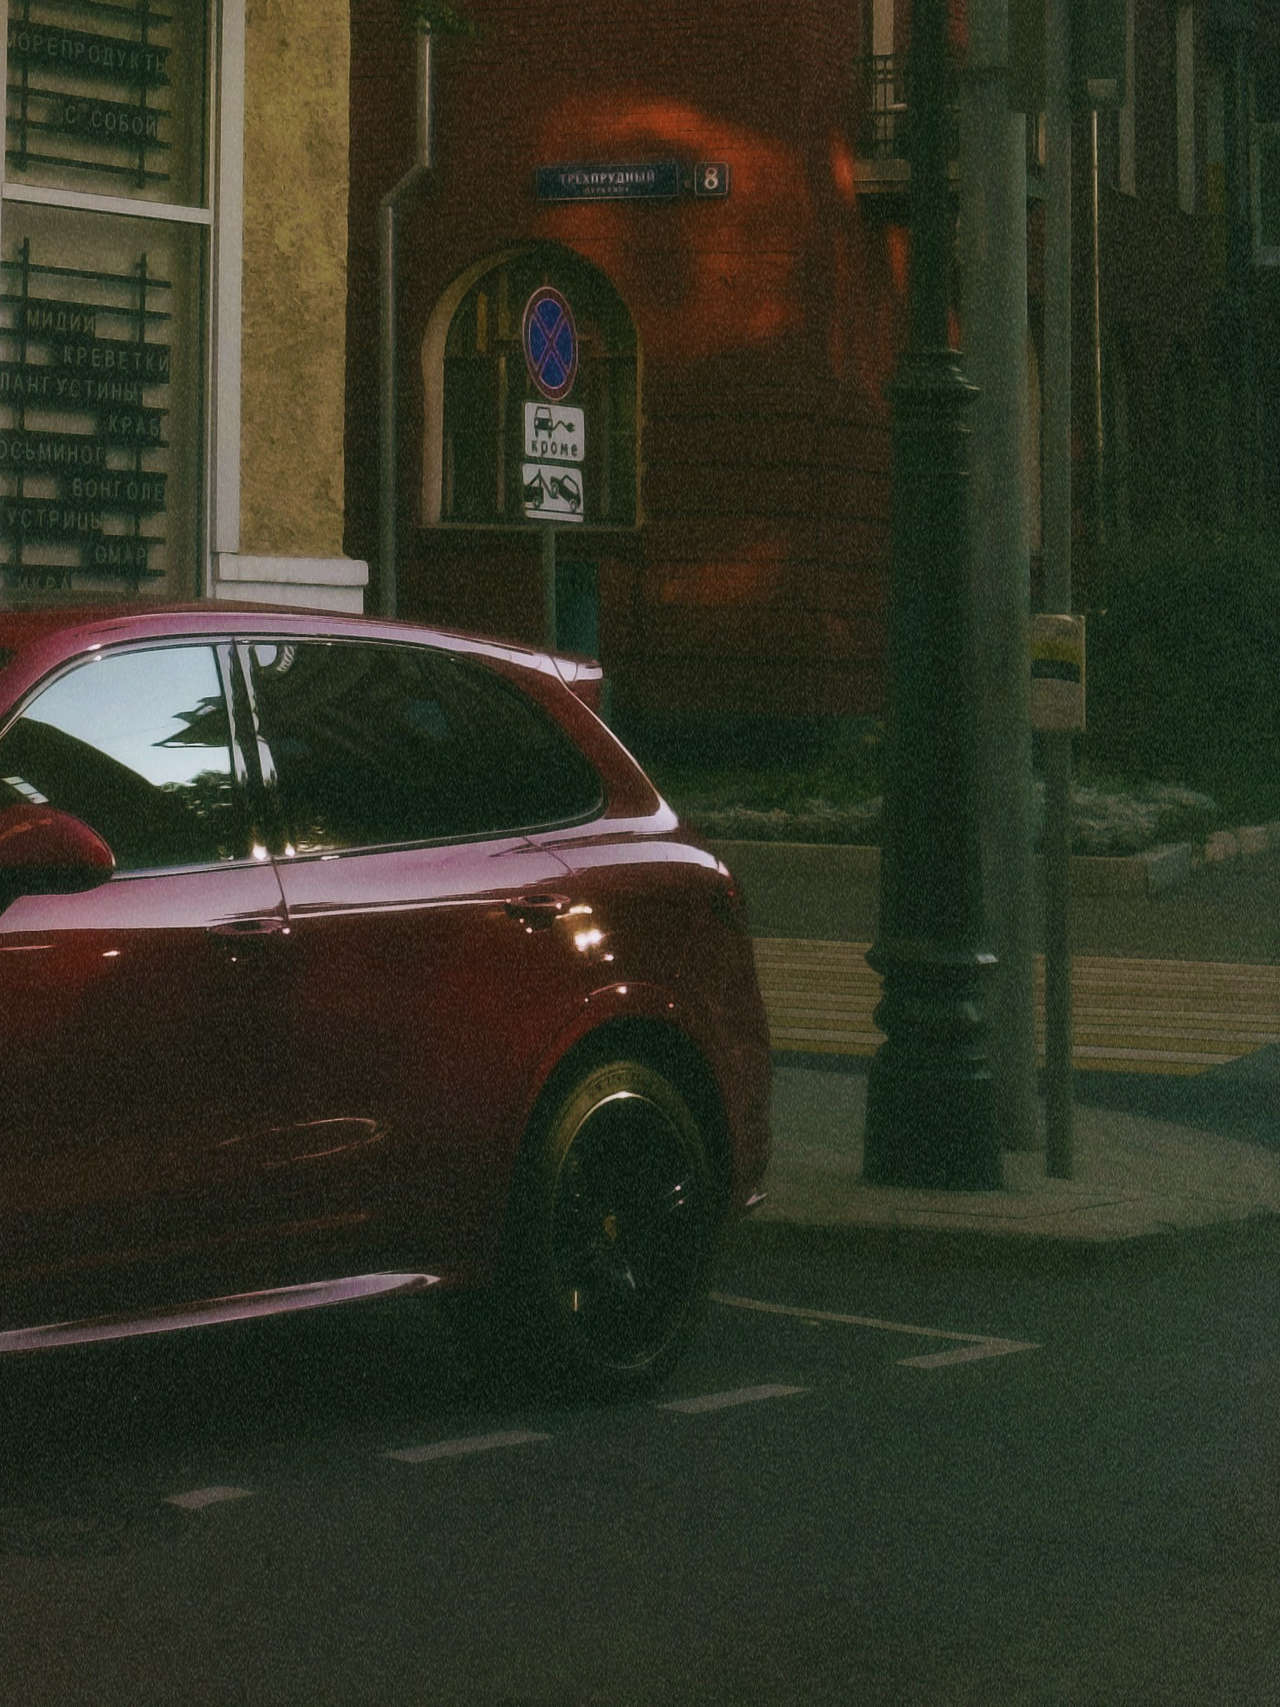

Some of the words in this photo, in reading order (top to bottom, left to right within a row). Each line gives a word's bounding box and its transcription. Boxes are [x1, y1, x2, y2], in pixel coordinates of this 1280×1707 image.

[65, 105, 76, 124] С
[91, 109, 158, 137] СОБОЙ
[703, 167, 719, 190] 8
[26, 309, 96, 333] МИДИИ
[63, 345, 169, 372] КРЕВЕТКИ
[108, 414, 160, 438] КРАБ
[531, 440, 578, 458] кроме
[72, 477, 165, 502] ВОНГОЛЕ
[7, 508, 102, 530] УСТРИЦЫ
[94, 545, 147, 564] ОМАР
